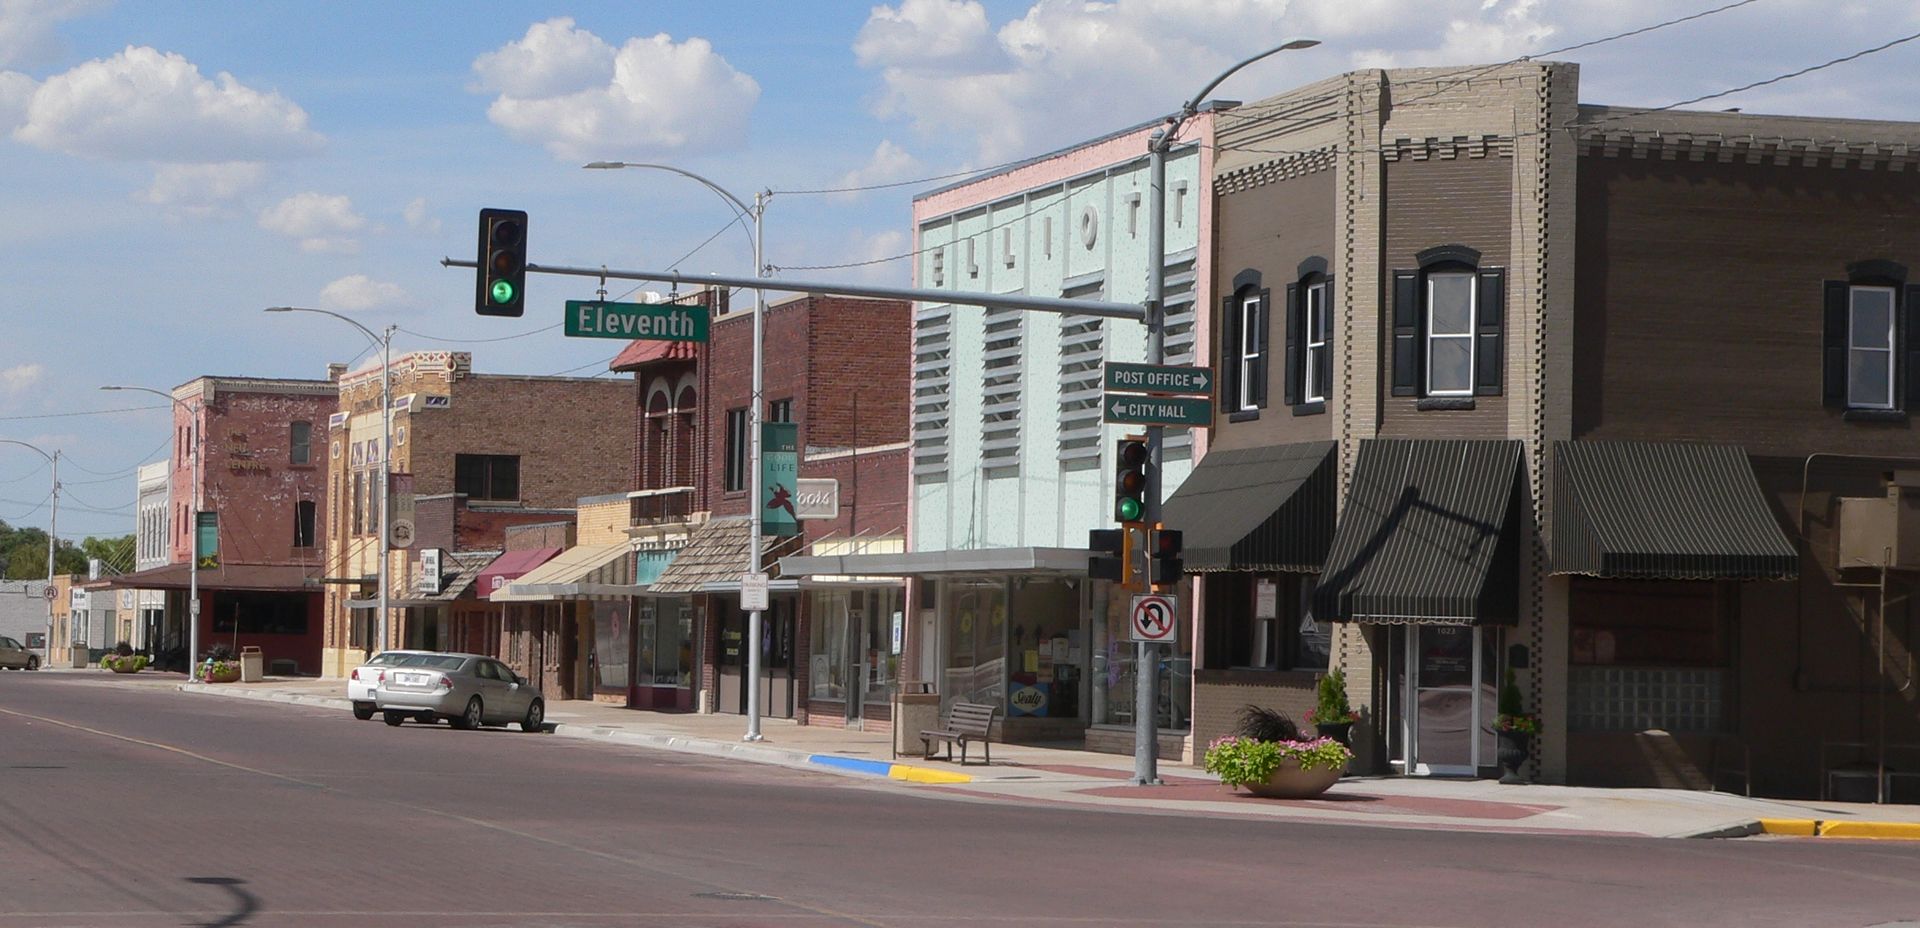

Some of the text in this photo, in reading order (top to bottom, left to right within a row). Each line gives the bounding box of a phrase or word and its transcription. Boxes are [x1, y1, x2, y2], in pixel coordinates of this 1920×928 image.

[932, 180, 1188, 288] ELLIOTT
[578, 305, 695, 337] Eleventh
[1115, 371, 1190, 386] POST OFFICE
[1128, 403, 1186, 418] CITY HALL
[770, 463, 795, 472] LIFE
[1013, 690, 1042, 708] Sealy
